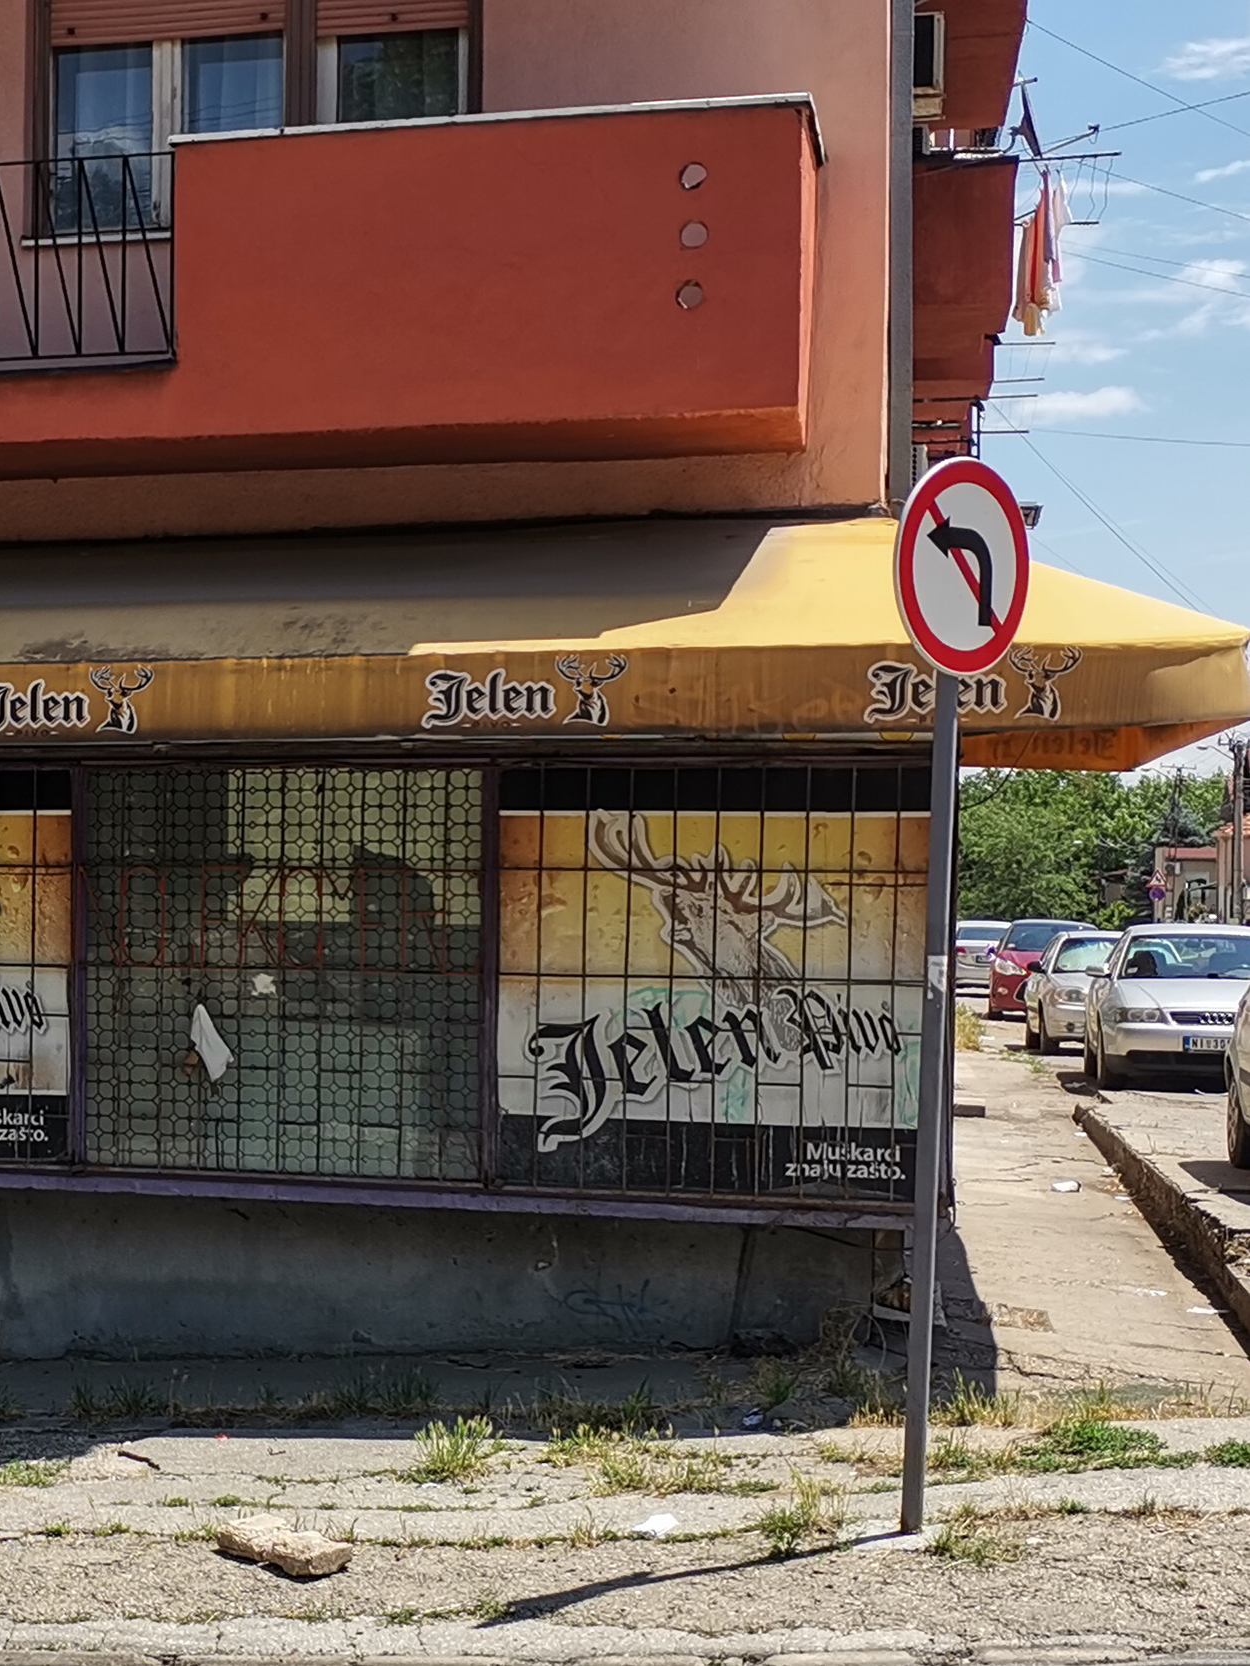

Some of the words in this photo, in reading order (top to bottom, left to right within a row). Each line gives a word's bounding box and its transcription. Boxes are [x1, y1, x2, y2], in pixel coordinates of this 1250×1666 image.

[421, 668, 557, 729] Jelen
[864, 660, 1007, 725] Jeen
[526, 1000, 786, 1152] Jelen
[785, 1159, 842, 1180] znaju
[846, 1161, 907, 1180] zašto.
